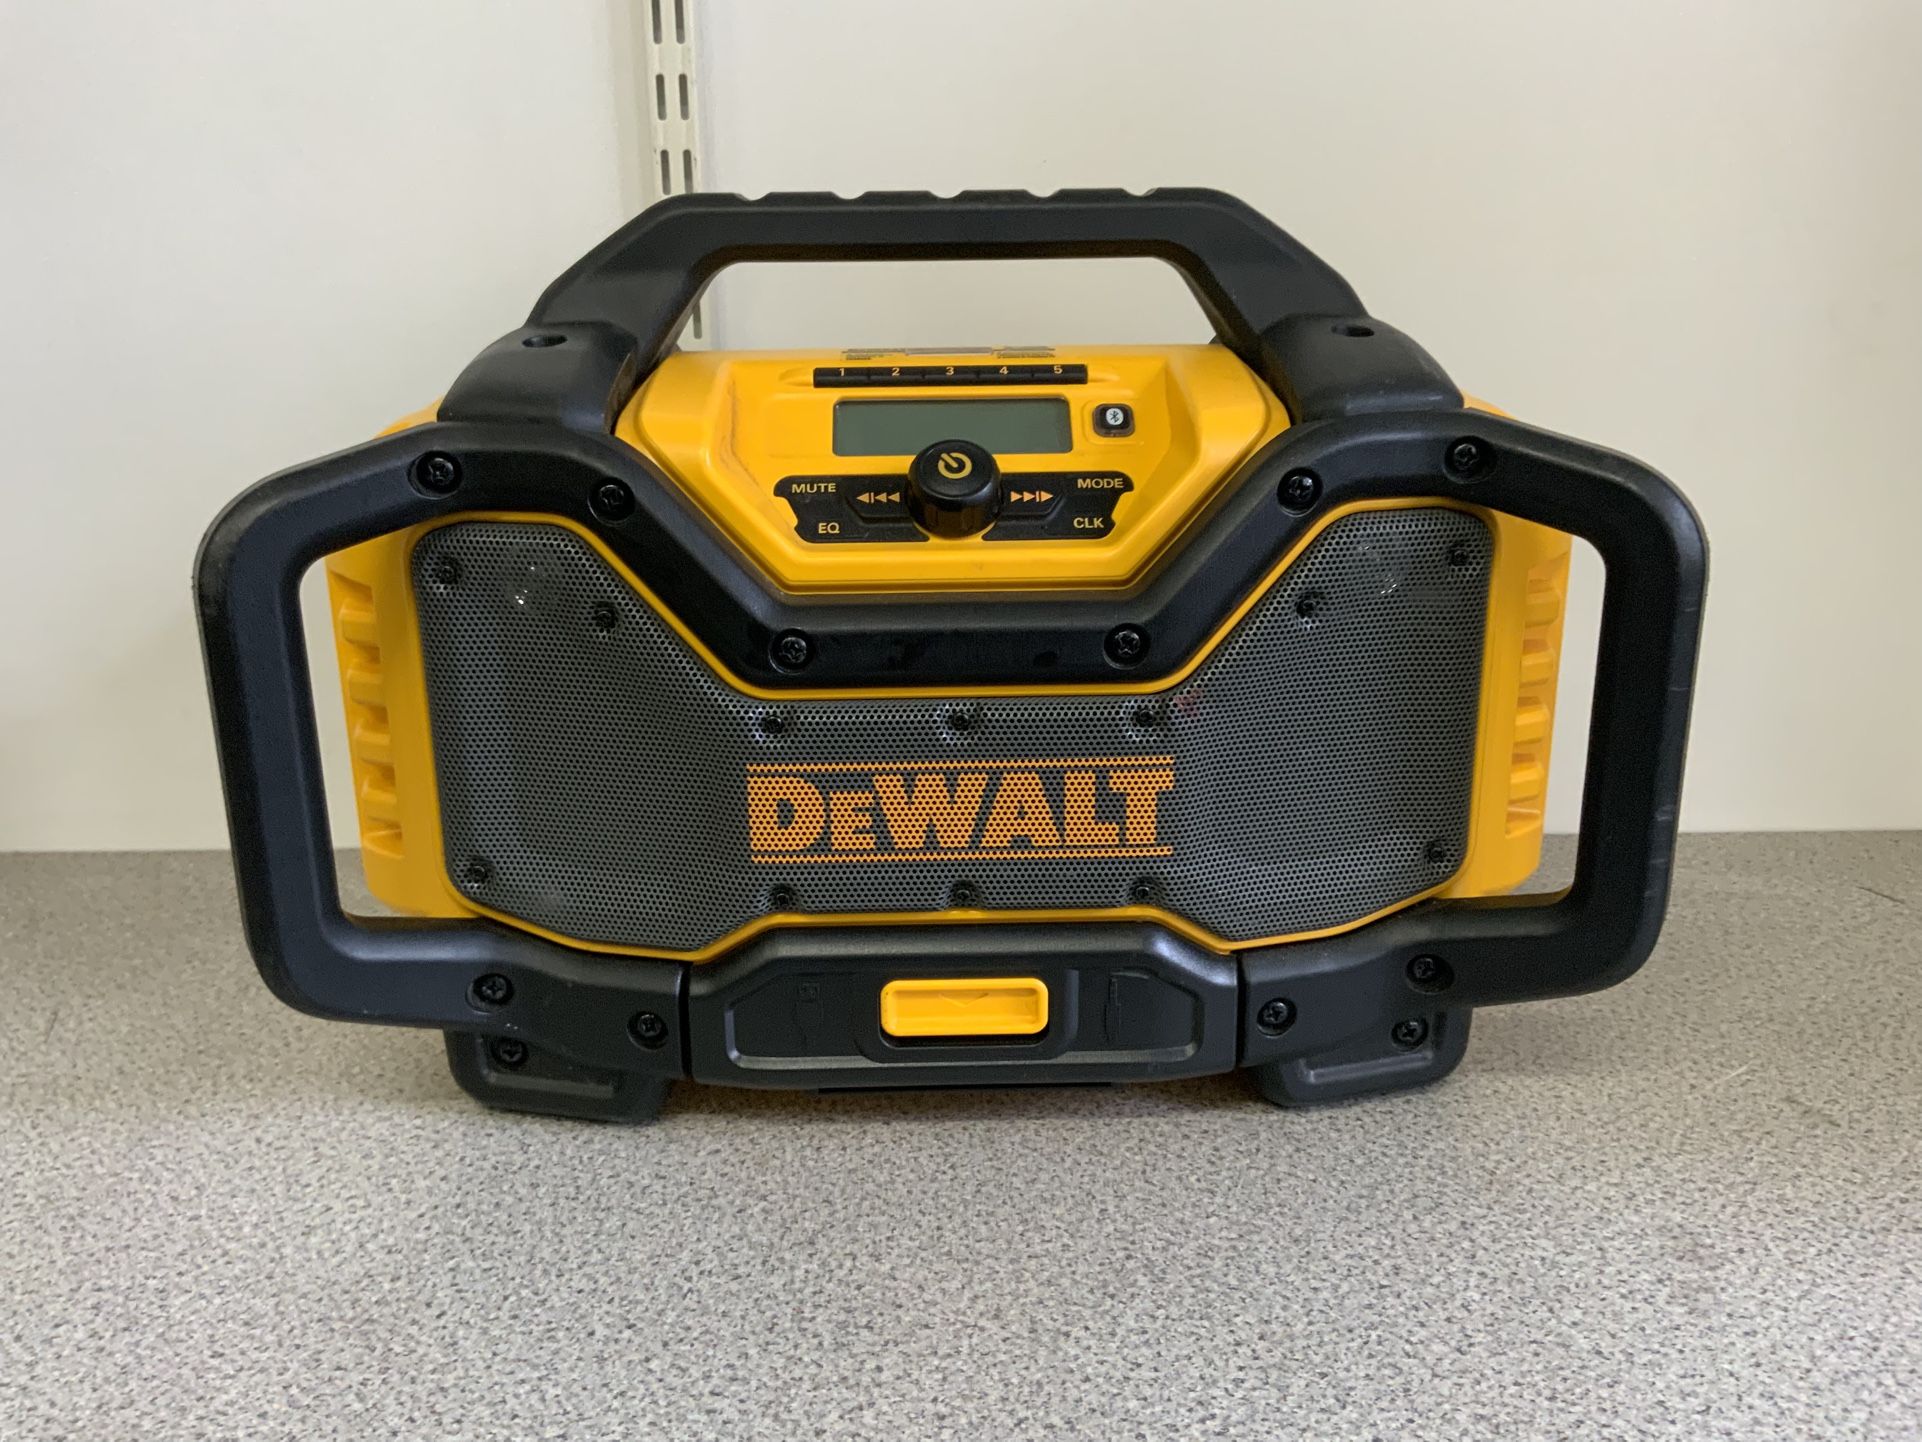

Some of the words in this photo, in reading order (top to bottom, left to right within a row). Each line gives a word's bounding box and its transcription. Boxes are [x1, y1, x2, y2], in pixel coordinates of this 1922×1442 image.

[891, 367, 900, 377] 2
[945, 365, 955, 376] 3
[999, 365, 1009, 375] 4
[1053, 364, 1063, 375] 5
[791, 483, 837, 494] MUTE
[1077, 478, 1124, 489] MODE
[818, 522, 841, 534] EQ
[1073, 517, 1105, 529] CLK
